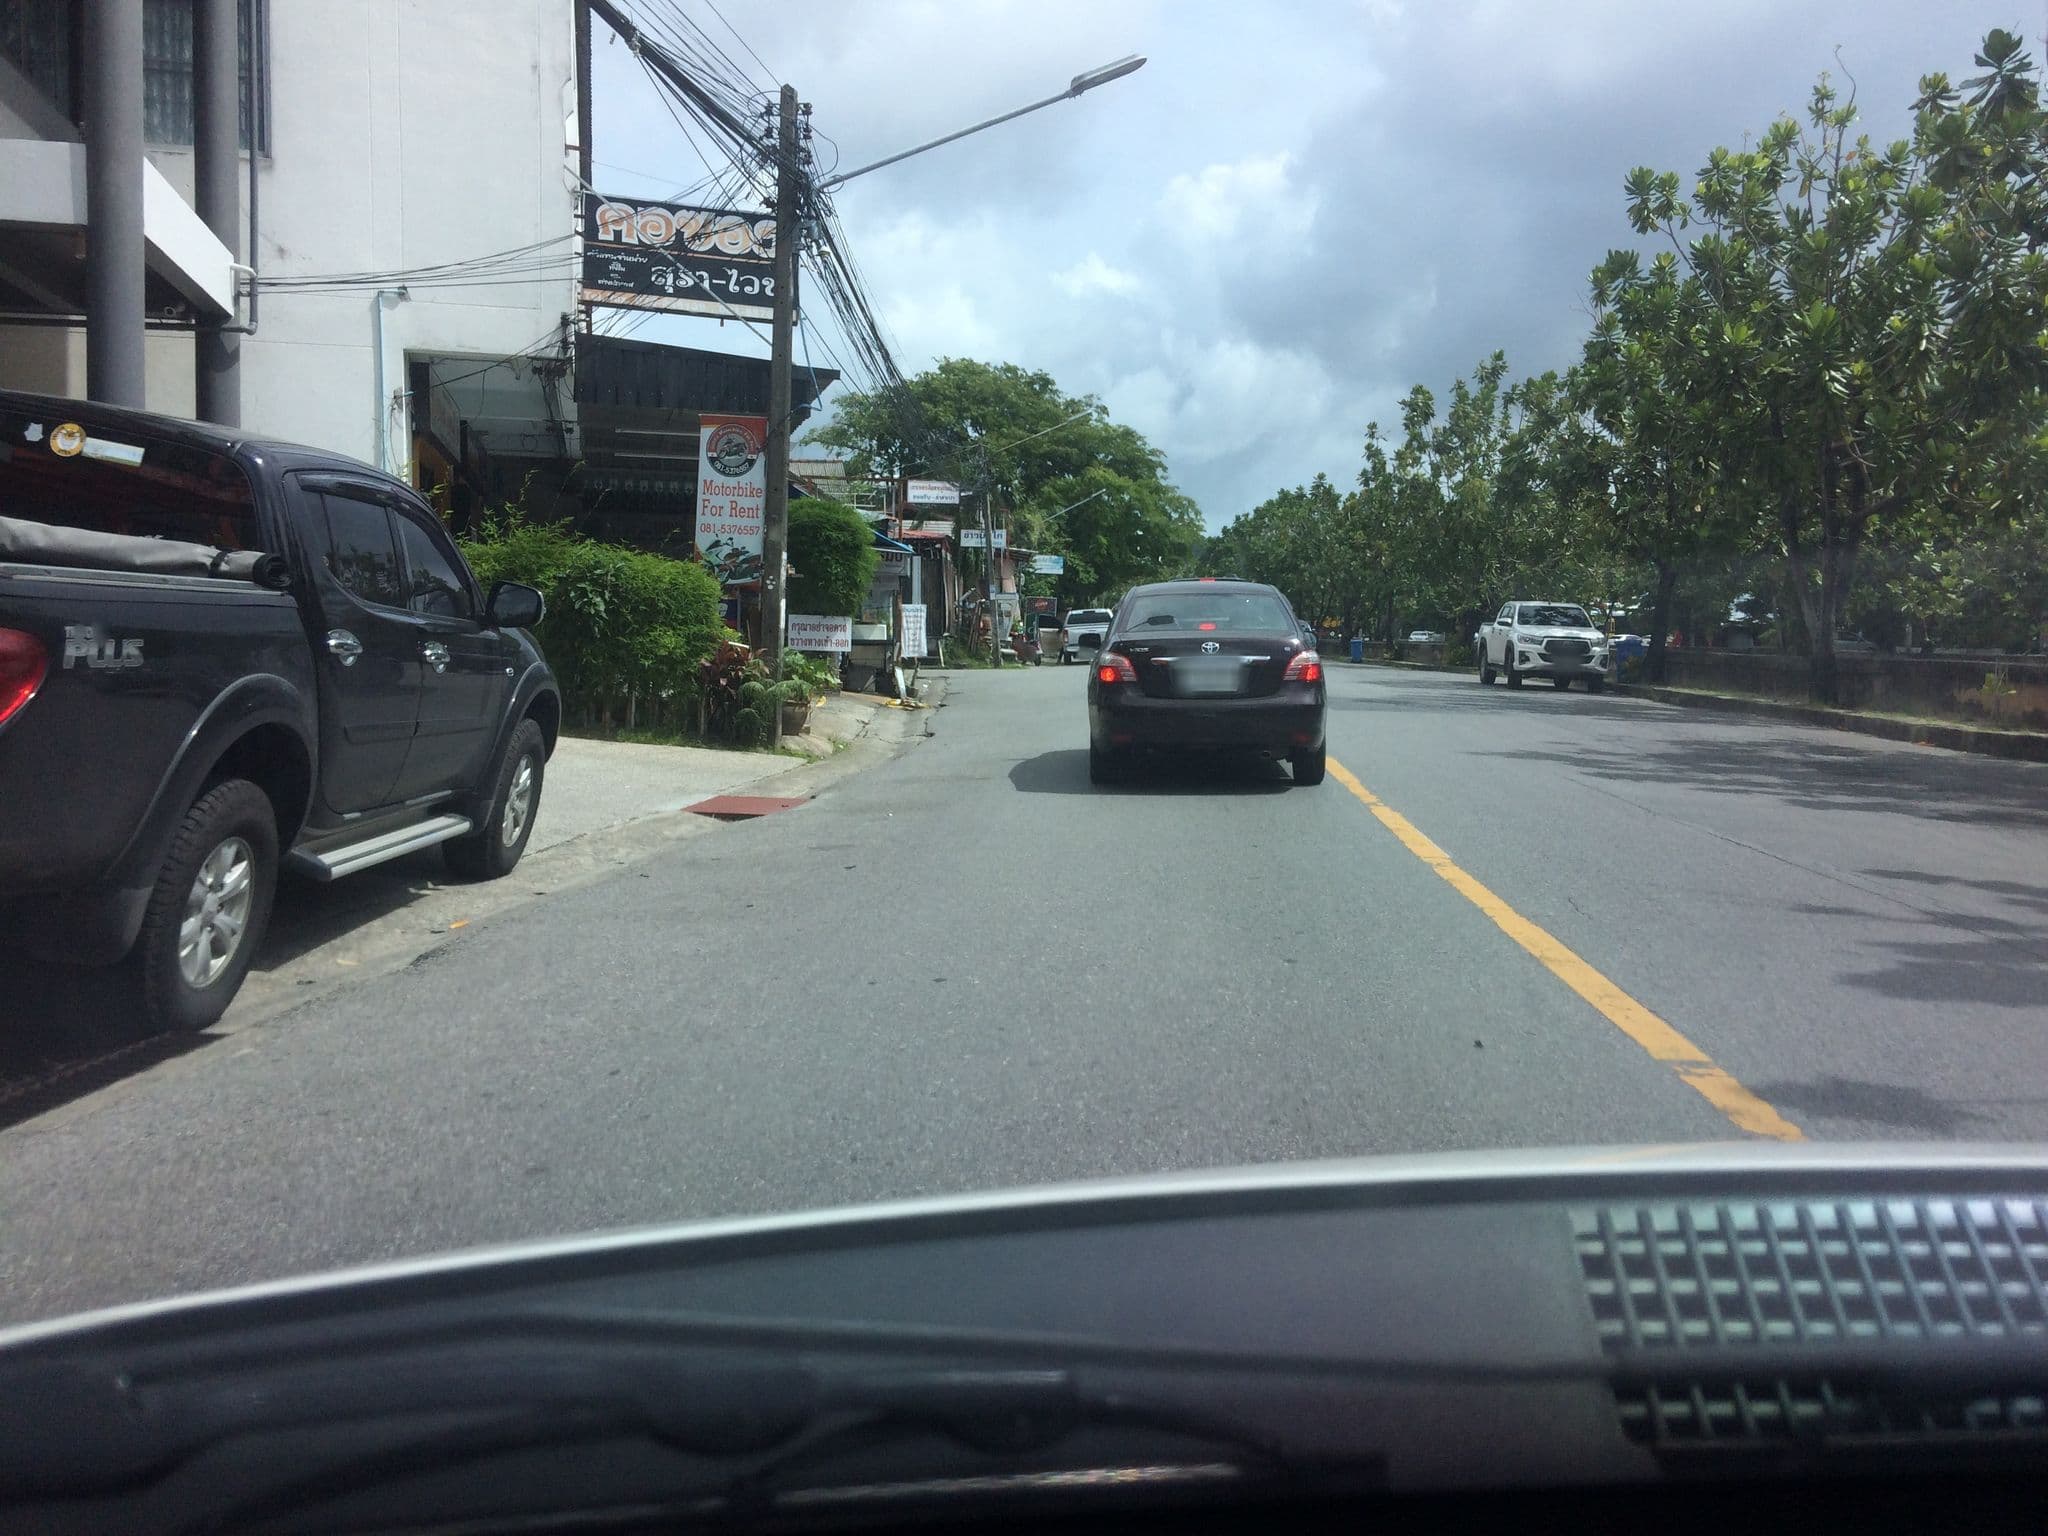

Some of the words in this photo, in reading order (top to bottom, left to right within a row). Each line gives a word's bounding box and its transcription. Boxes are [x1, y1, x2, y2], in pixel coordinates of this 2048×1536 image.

[703, 479, 763, 499] Motorbike
[701, 499, 724, 517] For
[729, 500, 761, 519] Rent
[700, 522, 761, 536] 081-5376557
